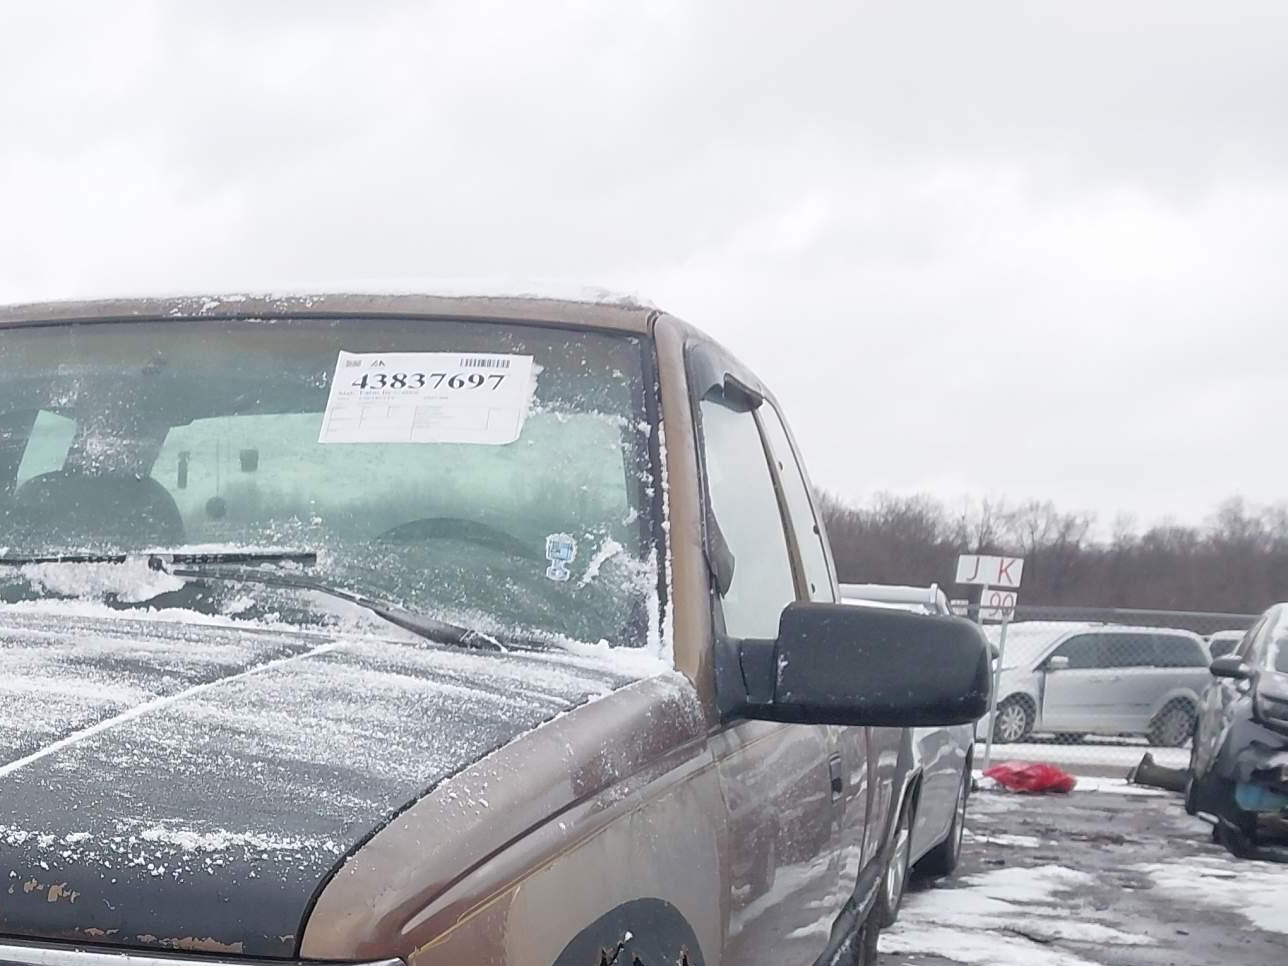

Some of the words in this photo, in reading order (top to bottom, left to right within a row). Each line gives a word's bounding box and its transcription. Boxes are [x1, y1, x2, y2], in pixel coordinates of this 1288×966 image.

[351, 373, 505, 390] 43837697
[966, 556, 981, 582] J
[997, 558, 1017, 585] K
